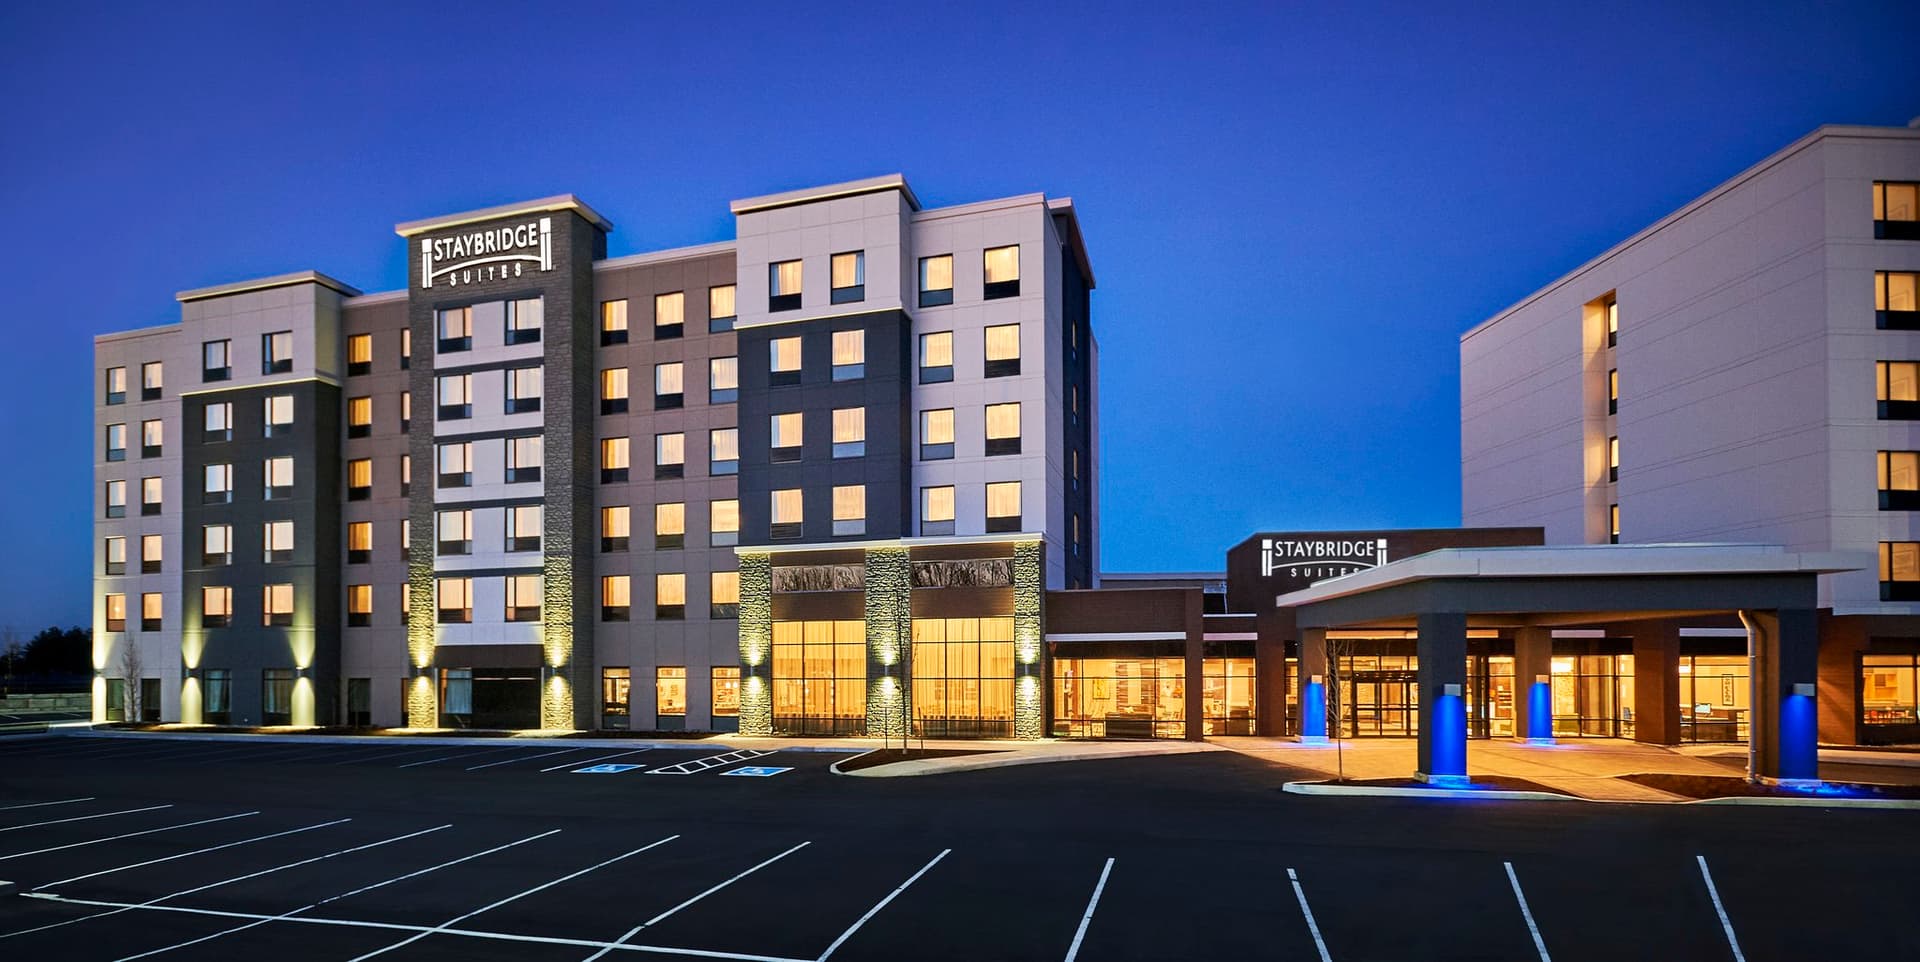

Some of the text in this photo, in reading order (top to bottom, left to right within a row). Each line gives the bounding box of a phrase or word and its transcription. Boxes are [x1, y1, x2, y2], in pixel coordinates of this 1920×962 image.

[434, 223, 538, 261] STAYBRIDGE
[450, 262, 522, 286] SUITES
[1274, 541, 1374, 557] STAYBRIDGE
[1290, 567, 1360, 577] SUITES
